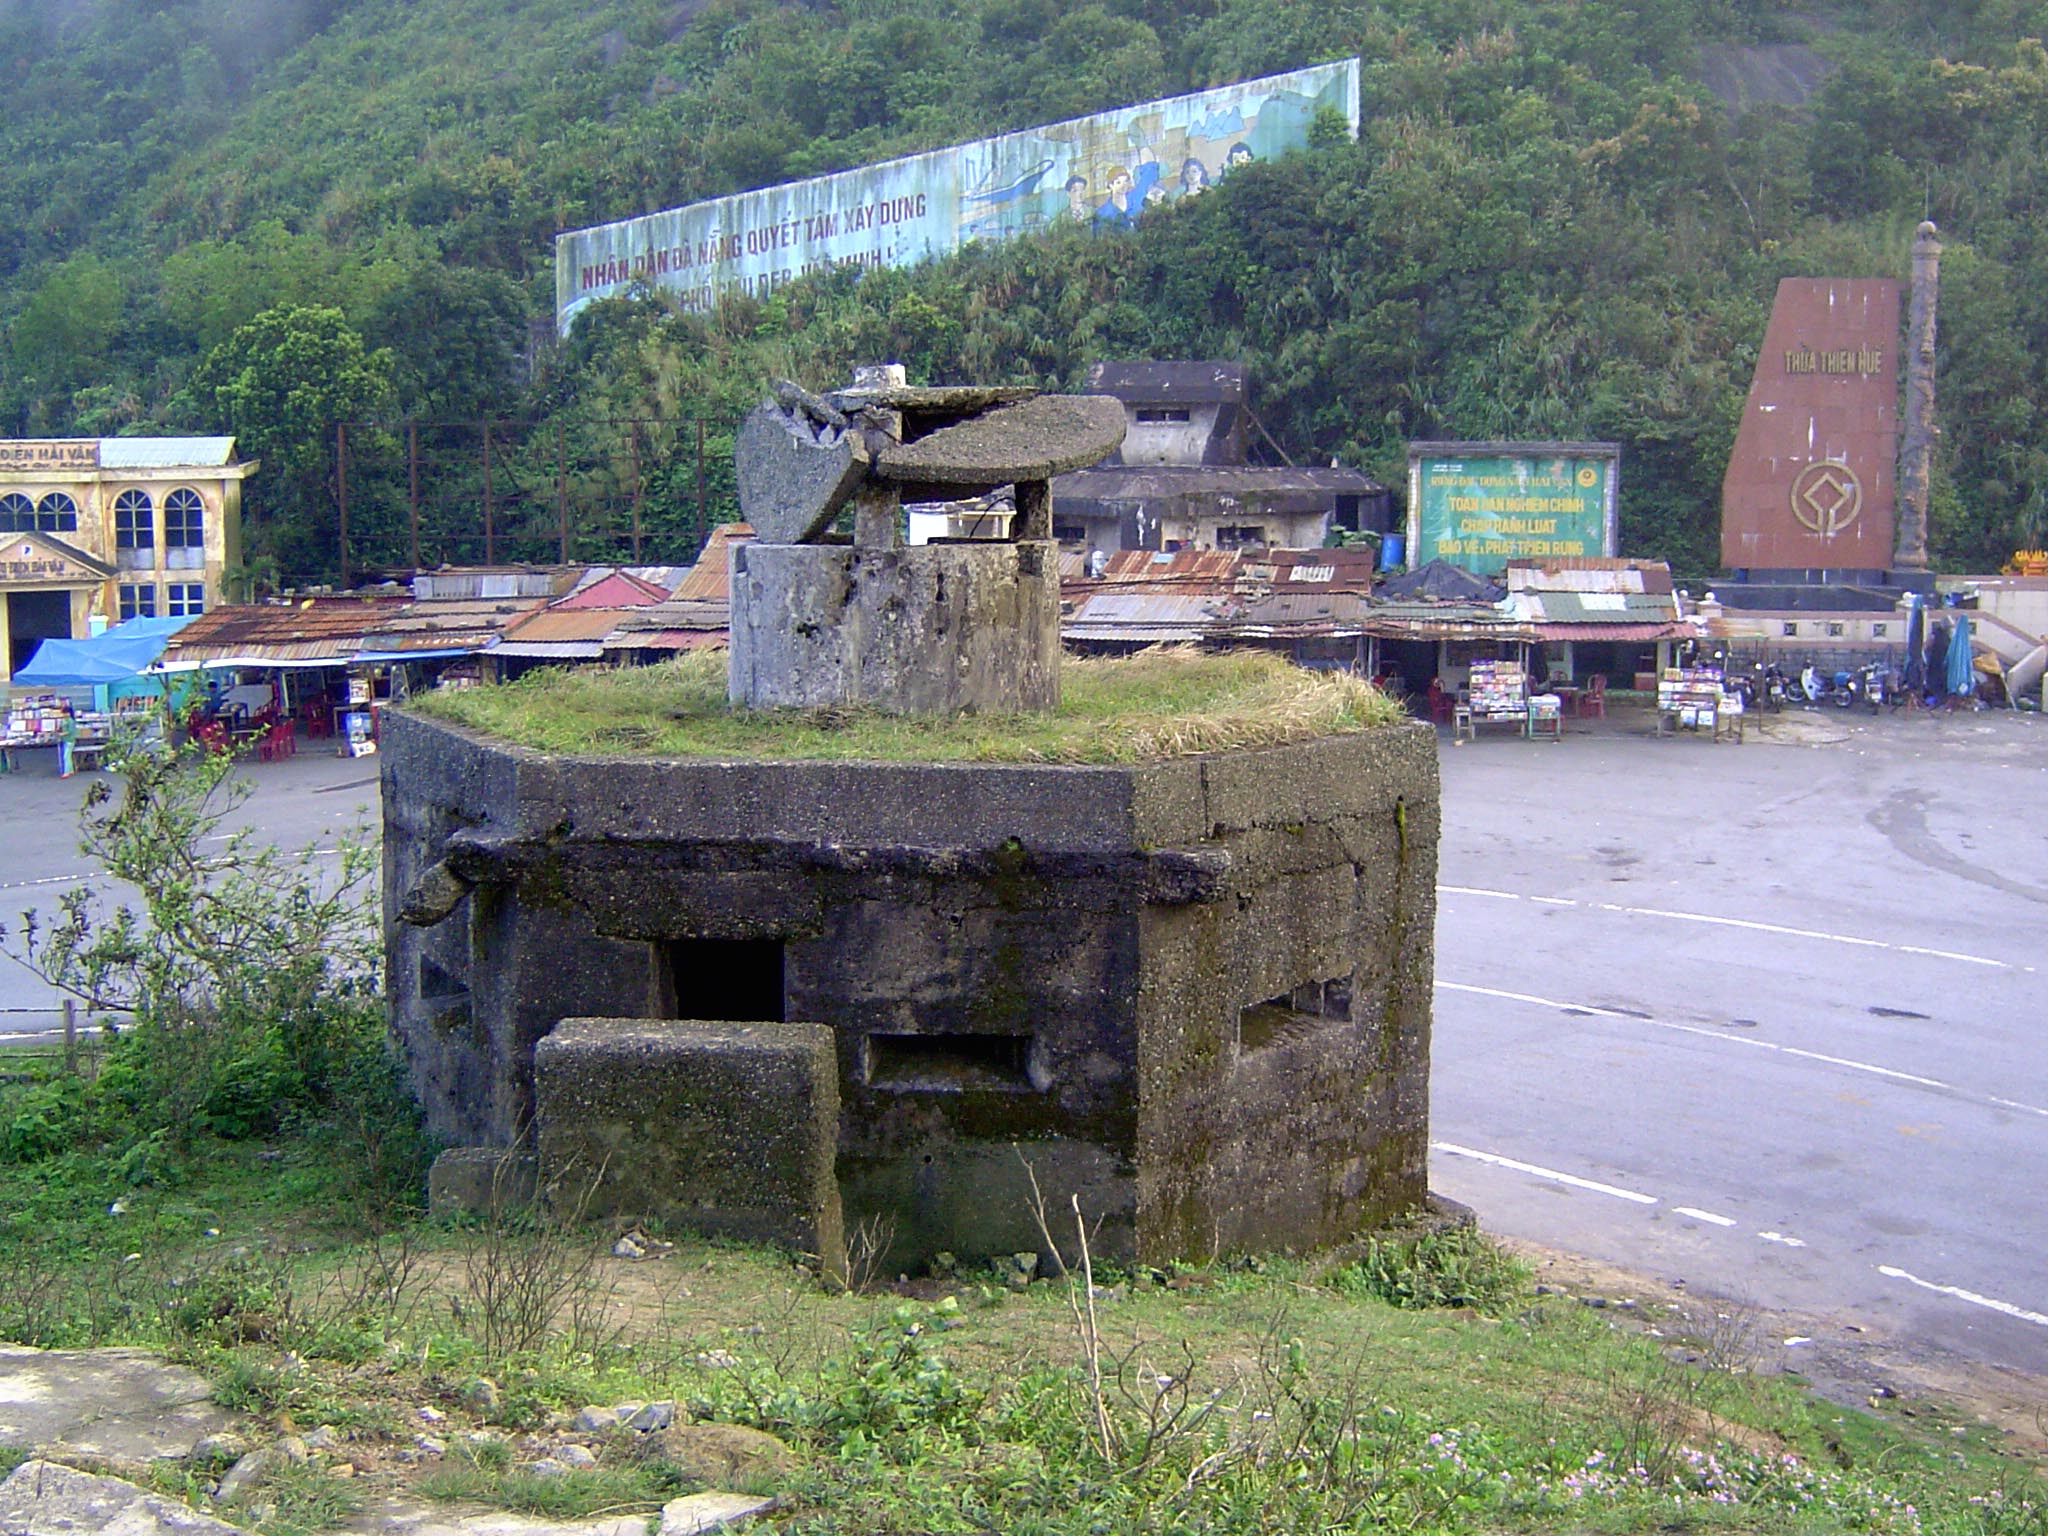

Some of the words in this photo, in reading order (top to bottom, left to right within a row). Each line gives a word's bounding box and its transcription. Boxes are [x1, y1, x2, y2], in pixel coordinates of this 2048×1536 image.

[582, 254, 629, 290] NHÂN
[805, 209, 838, 242] TÂM
[844, 201, 875, 234] XÂY
